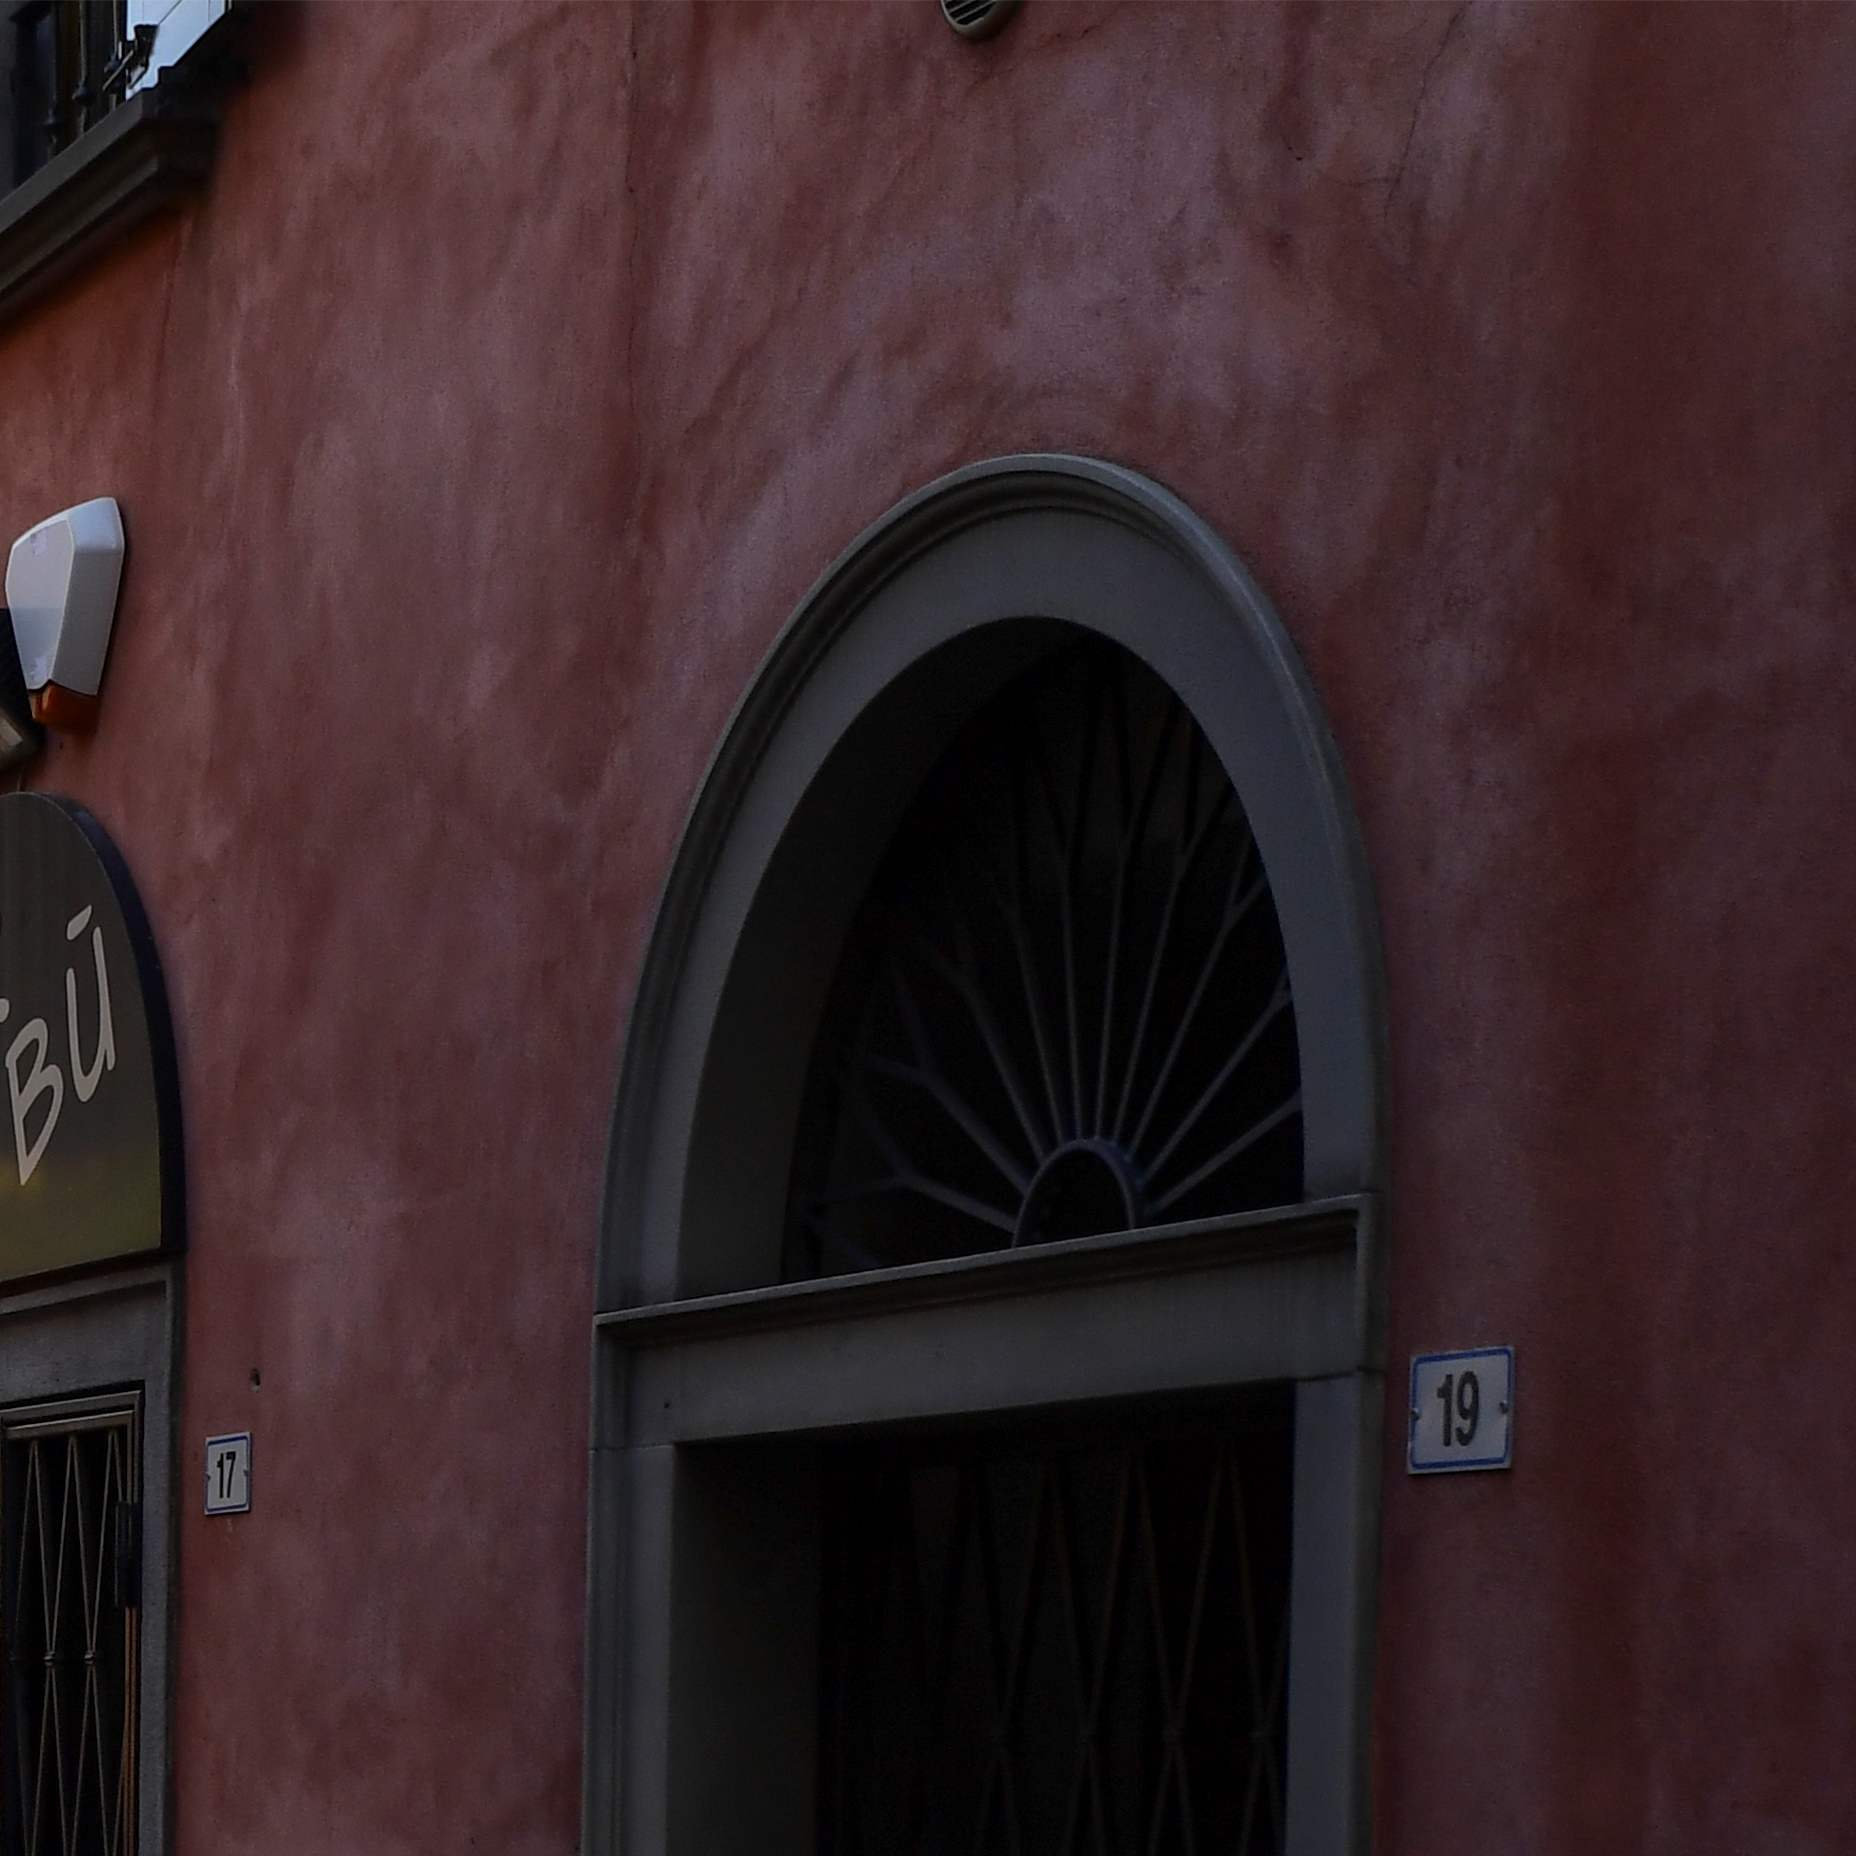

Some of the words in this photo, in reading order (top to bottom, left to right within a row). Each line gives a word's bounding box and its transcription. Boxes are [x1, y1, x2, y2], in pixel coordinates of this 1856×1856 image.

[4, 904, 116, 1187] BÚ
[1436, 1370, 1480, 1447] 19
[216, 1450, 236, 1499] 17
